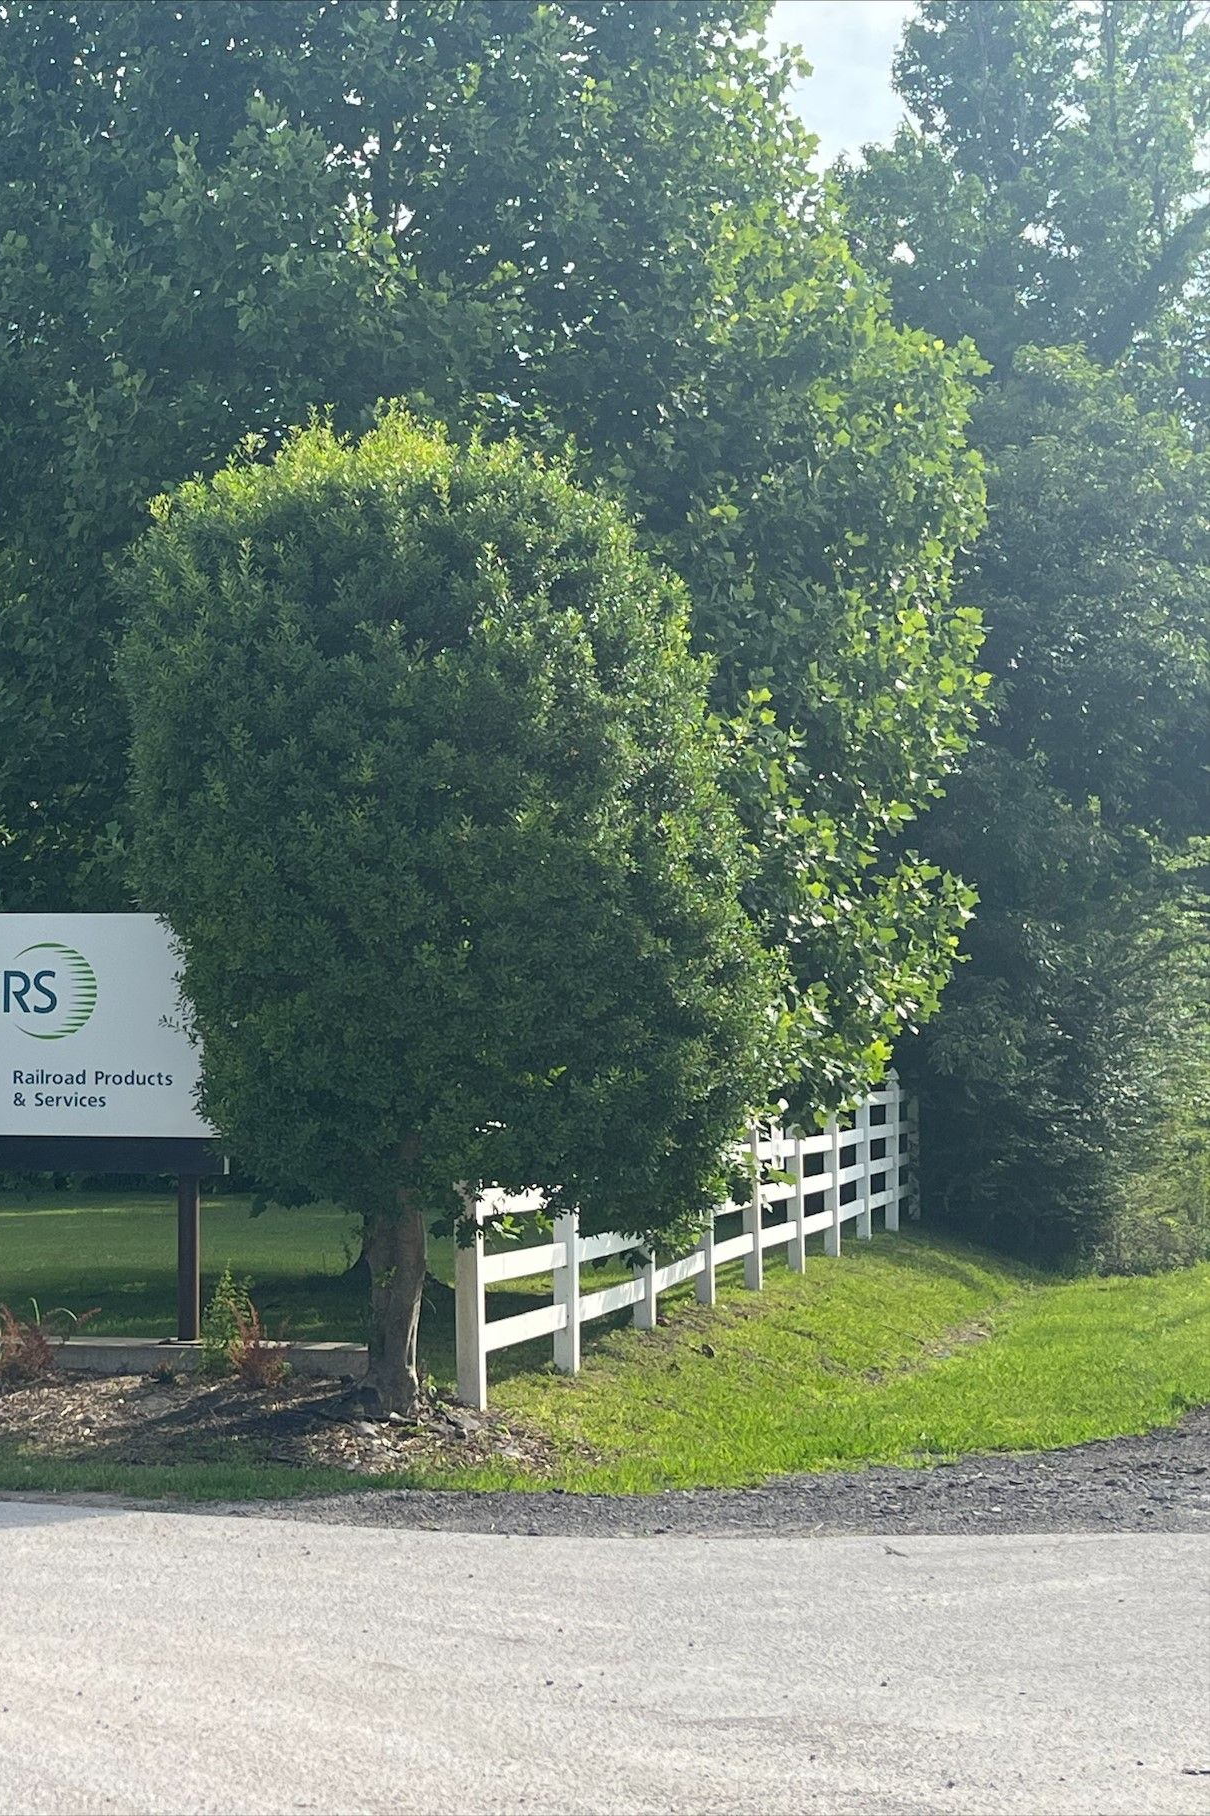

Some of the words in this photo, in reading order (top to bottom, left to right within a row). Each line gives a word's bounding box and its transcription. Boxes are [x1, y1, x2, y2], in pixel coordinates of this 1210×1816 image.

[12, 1069, 87, 1086] Railroad
[94, 1070, 174, 1087] Products
[12, 1092, 26, 1107] &
[34, 1092, 107, 1109] Services
